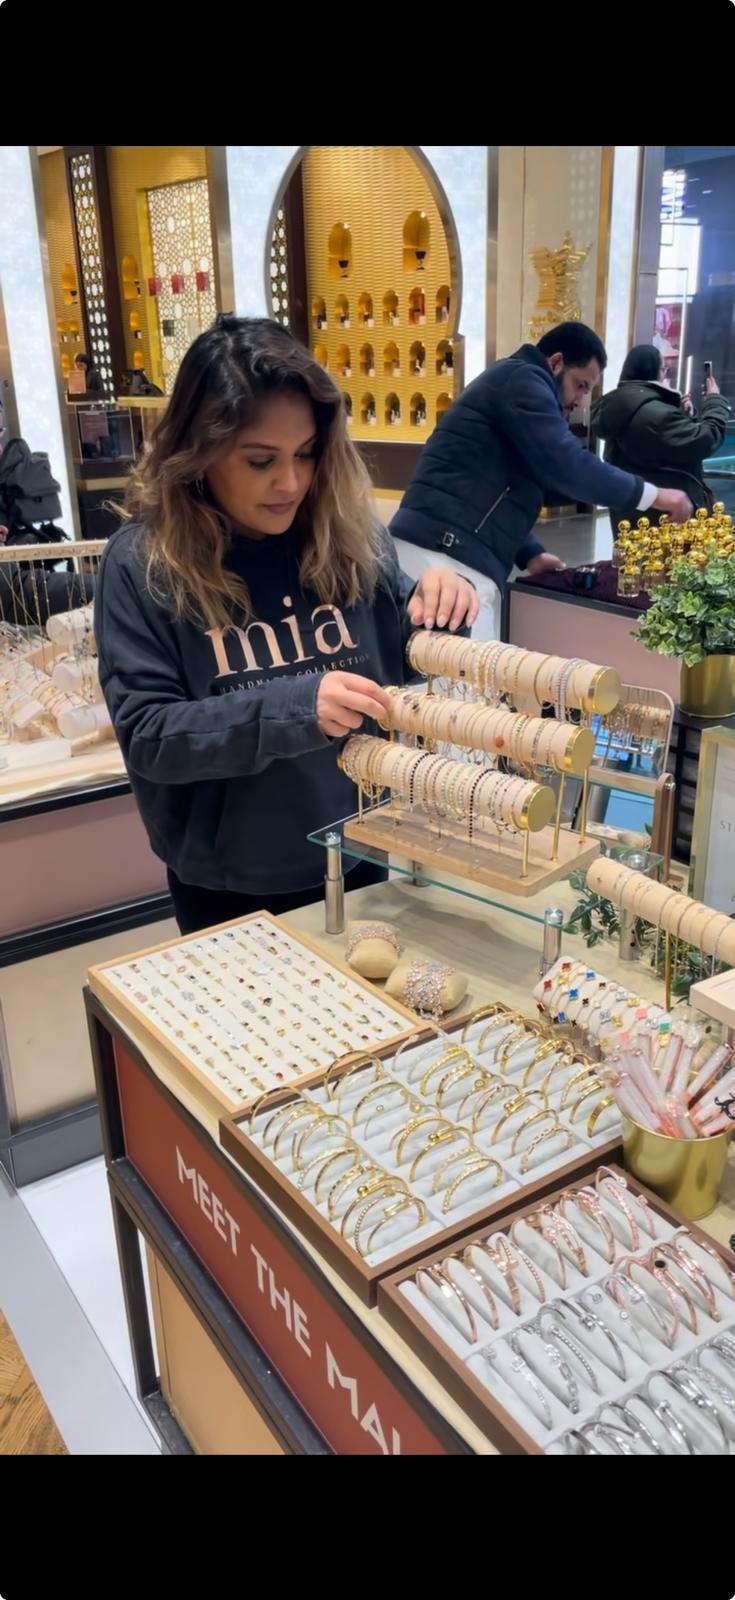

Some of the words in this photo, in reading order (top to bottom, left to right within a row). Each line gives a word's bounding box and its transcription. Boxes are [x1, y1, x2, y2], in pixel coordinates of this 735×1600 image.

[204, 595, 360, 679] mia
[176, 1144, 240, 1256] MEET
[250, 1243, 311, 1358] THE
[325, 1342, 400, 1455] MA
